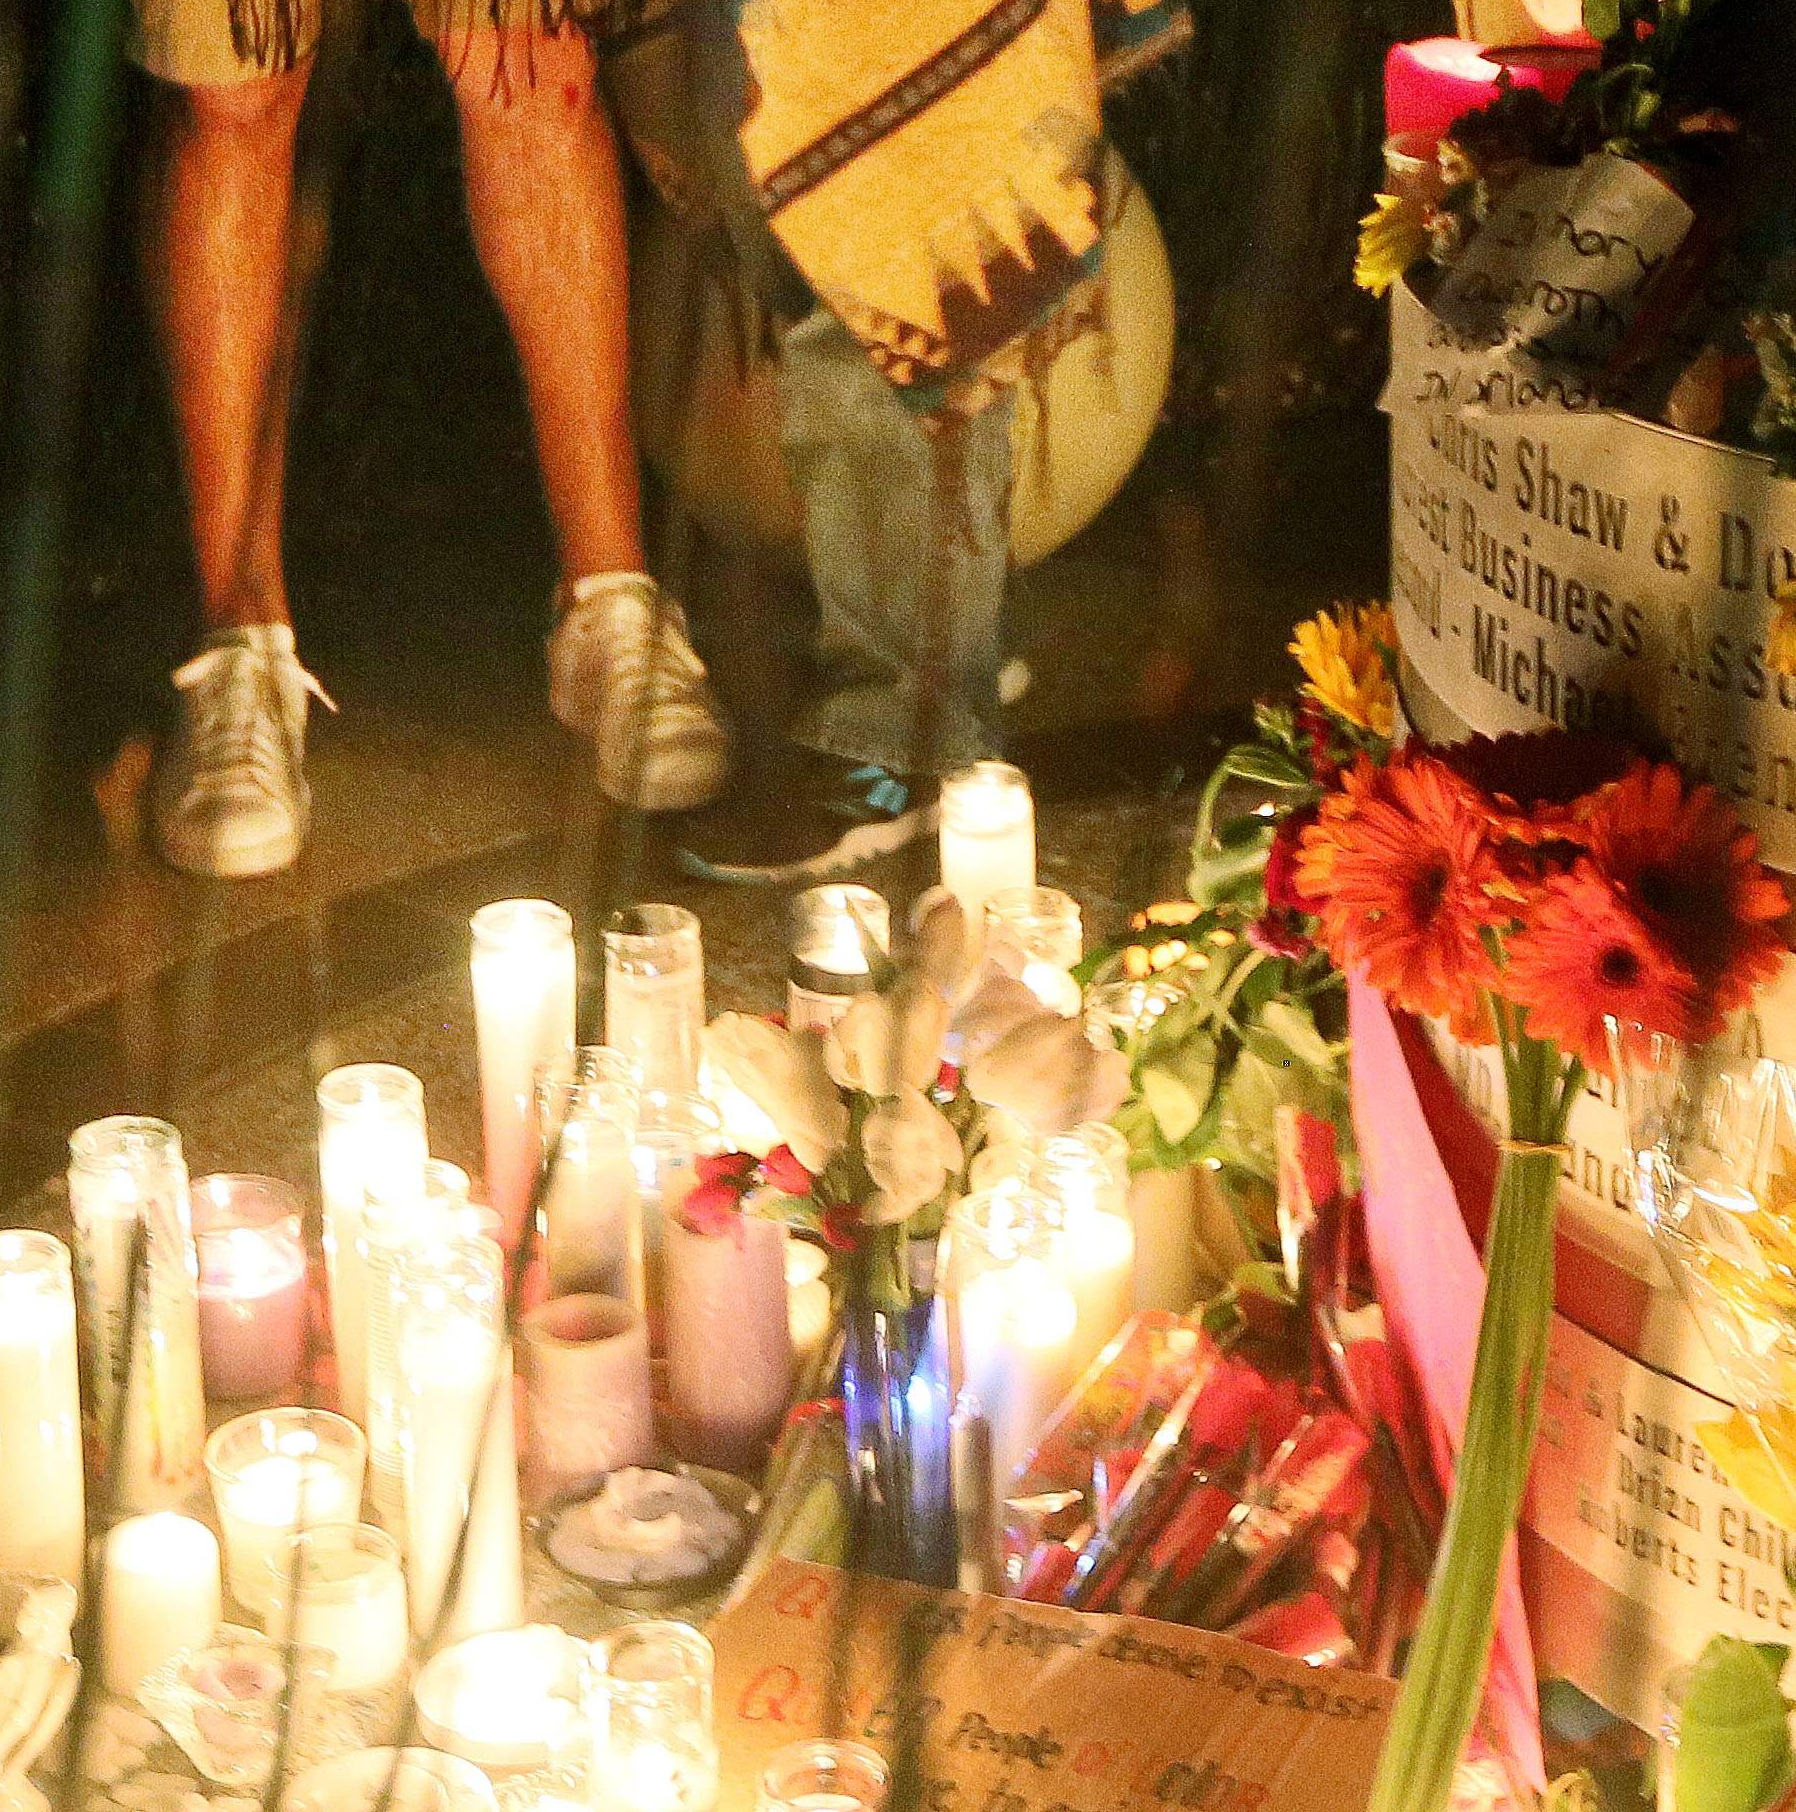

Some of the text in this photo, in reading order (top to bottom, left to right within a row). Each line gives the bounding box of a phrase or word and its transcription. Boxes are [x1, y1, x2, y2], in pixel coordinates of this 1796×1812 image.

[1459, 494, 1645, 660] Business
[1512, 434, 1633, 555] Shaw
[1654, 492, 1693, 579] &
